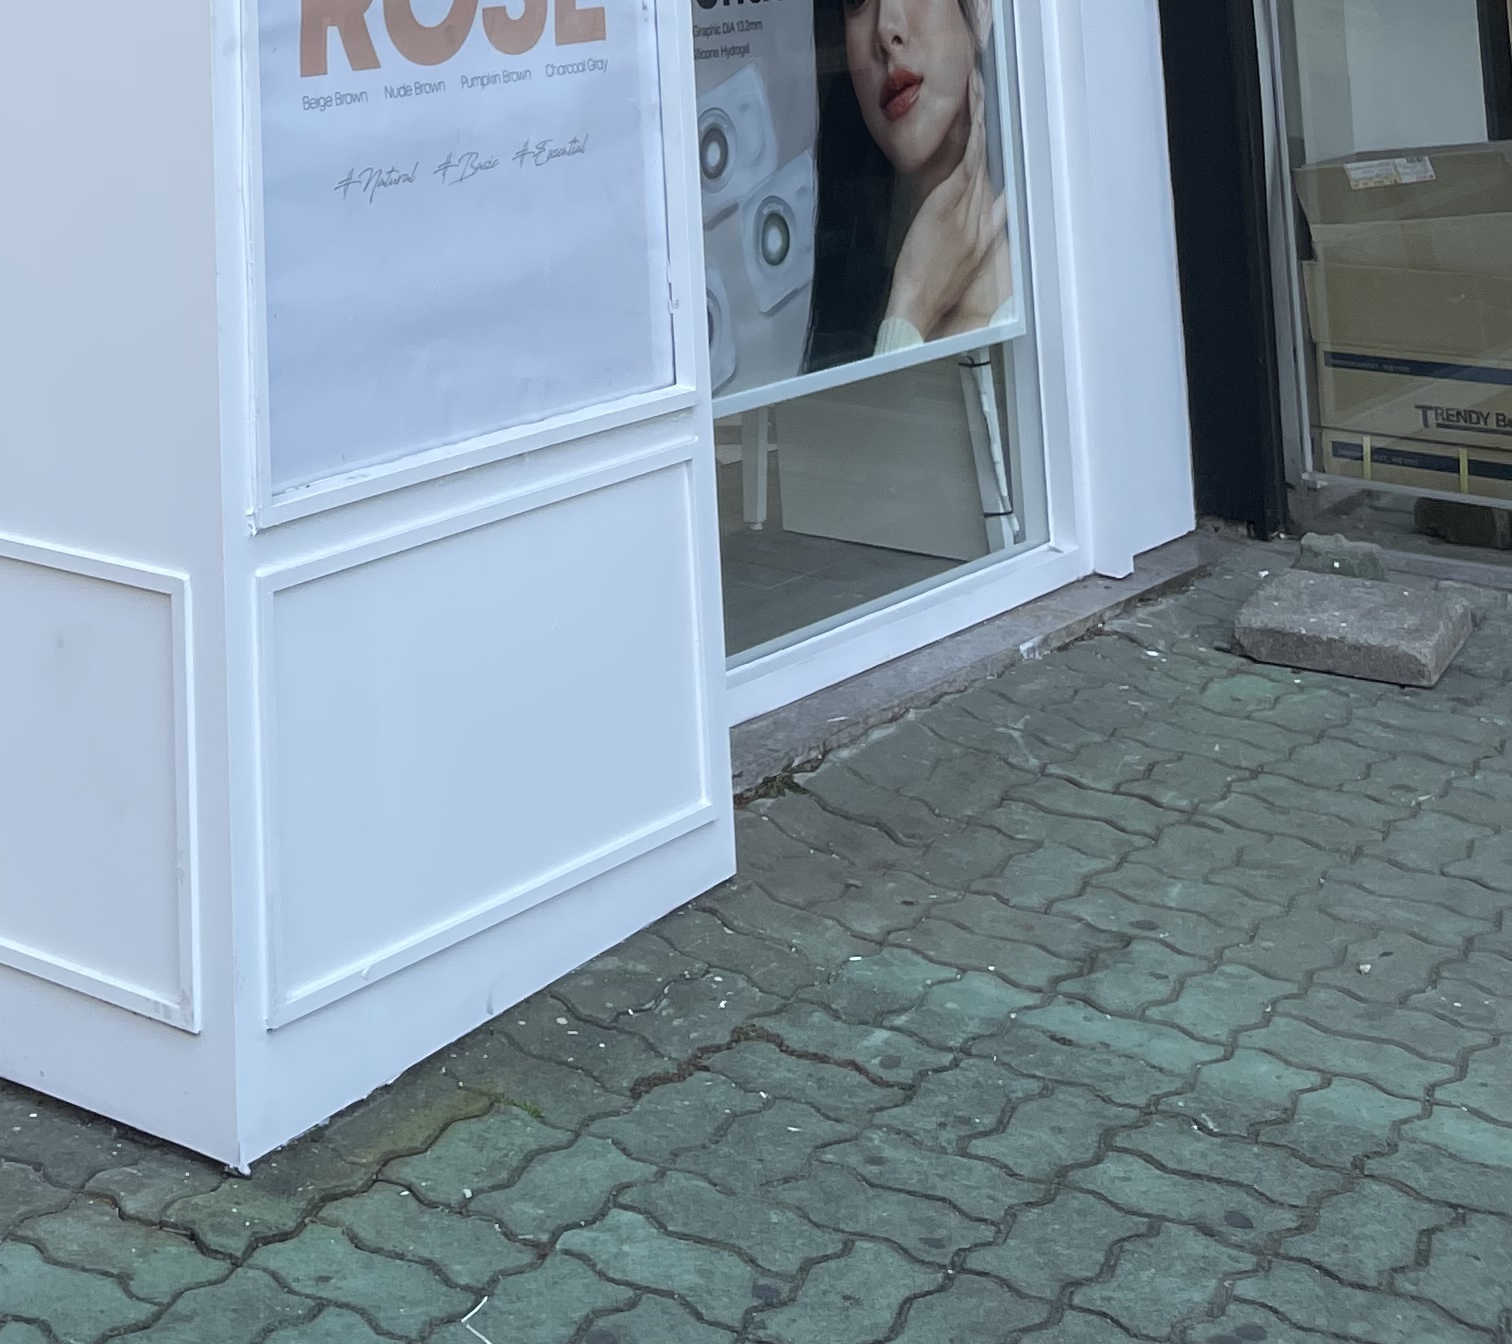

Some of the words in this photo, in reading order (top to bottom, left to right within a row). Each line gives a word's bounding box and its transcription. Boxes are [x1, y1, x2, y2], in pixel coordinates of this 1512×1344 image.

[545, 60, 586, 78] Charcoal
[587, 58, 609, 75] Gray
[384, 84, 413, 100] Nude
[414, 79, 446, 96] Brown
[460, 71, 501, 91] Pumpkin
[502, 69, 532, 85] Brown
[302, 92, 333, 112] Beige
[335, 90, 368, 107] Brown
[1414, 404, 1491, 429] TRENDY
